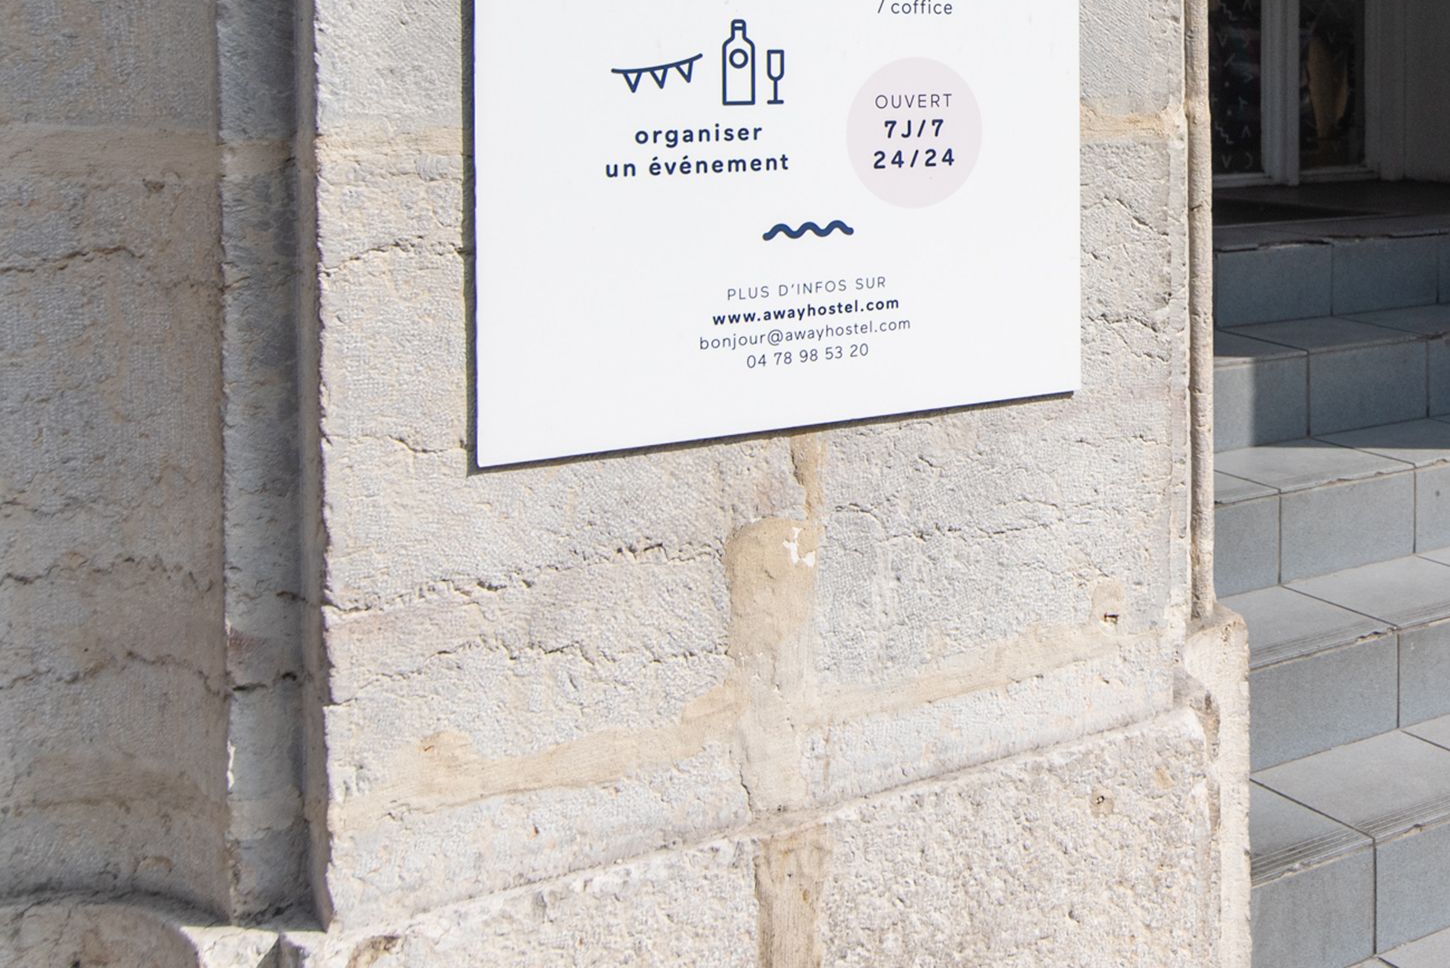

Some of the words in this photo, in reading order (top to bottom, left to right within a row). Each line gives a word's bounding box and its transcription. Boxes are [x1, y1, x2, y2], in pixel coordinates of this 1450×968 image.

[891, 0, 952, 15] coffice
[875, 93, 952, 109] OUVERT
[635, 123, 762, 149] organiser
[884, 119, 944, 139] 7J/7
[605, 163, 636, 178] un
[649, 154, 789, 176] événement
[873, 148, 955, 169] 24/24
[728, 286, 769, 300] PLUS
[779, 279, 846, 296] D'INFOS
[856, 276, 885, 290] SUR
[712, 299, 899, 325] www.awayhostel.com
[700, 317, 910, 351] bonjour@awayhostel.com
[747, 354, 767, 368] 04
[774, 351, 792, 365] 78
[799, 349, 818, 363] 98
[825, 346, 843, 360] 53
[850, 343, 868, 357] 20
